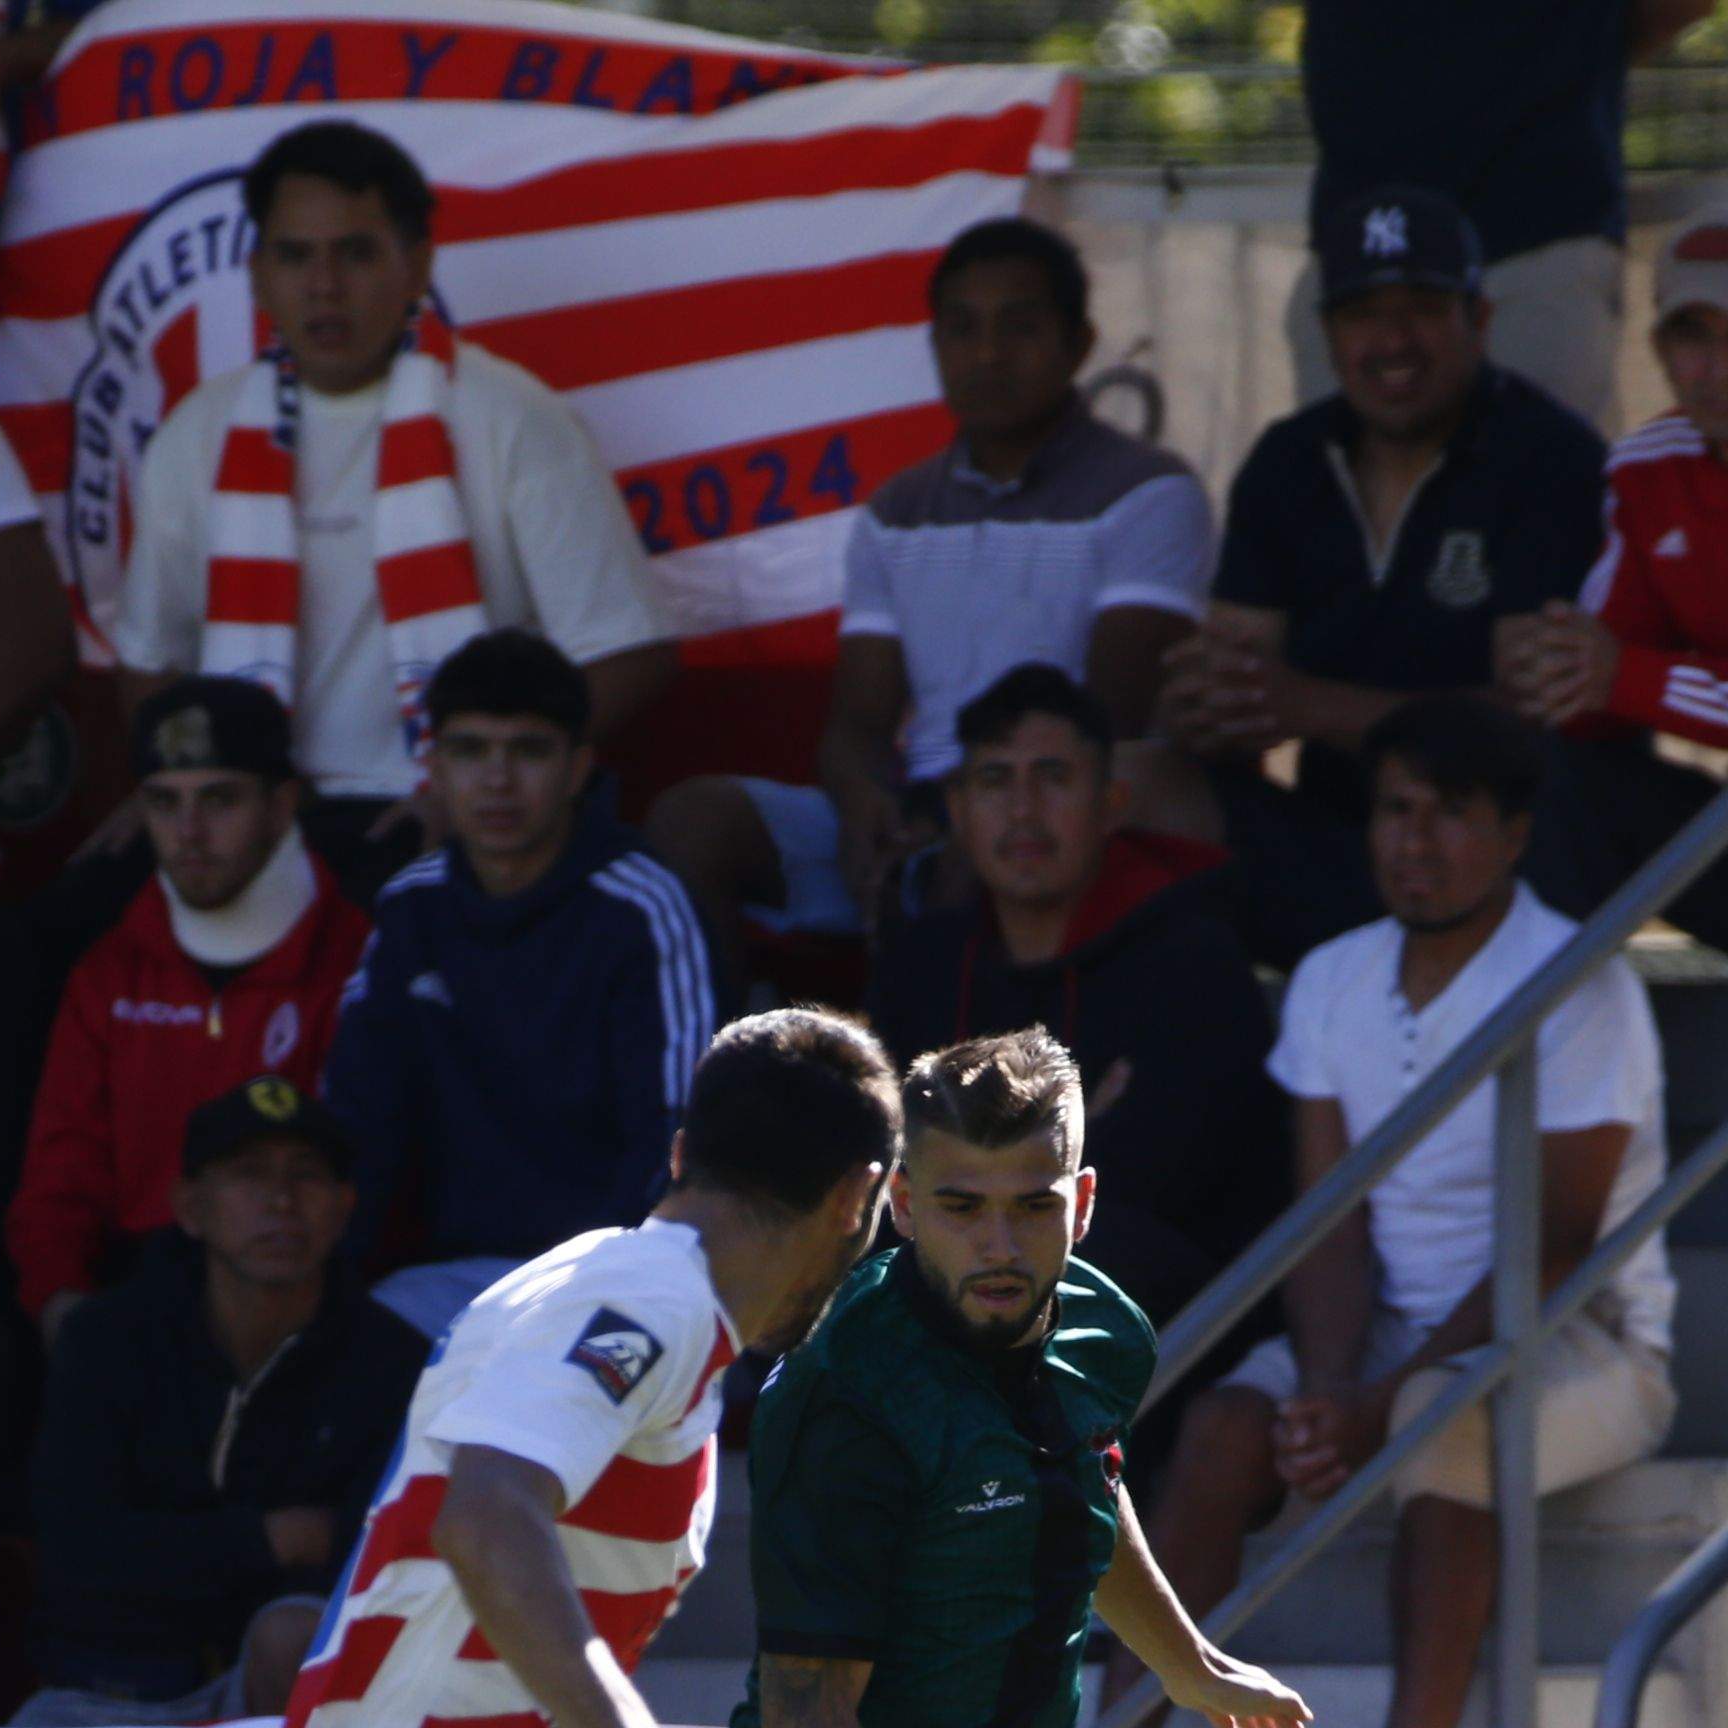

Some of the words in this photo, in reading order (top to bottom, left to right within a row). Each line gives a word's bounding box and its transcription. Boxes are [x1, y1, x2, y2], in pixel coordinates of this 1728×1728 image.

[116, 33, 340, 119] ROJA
[403, 34, 458, 98] Y
[501, 42, 820, 114] BLAN
[80, 372, 123, 543] CLUB
[108, 211, 262, 375] ATLETI
[625, 434, 859, 555] 2024
